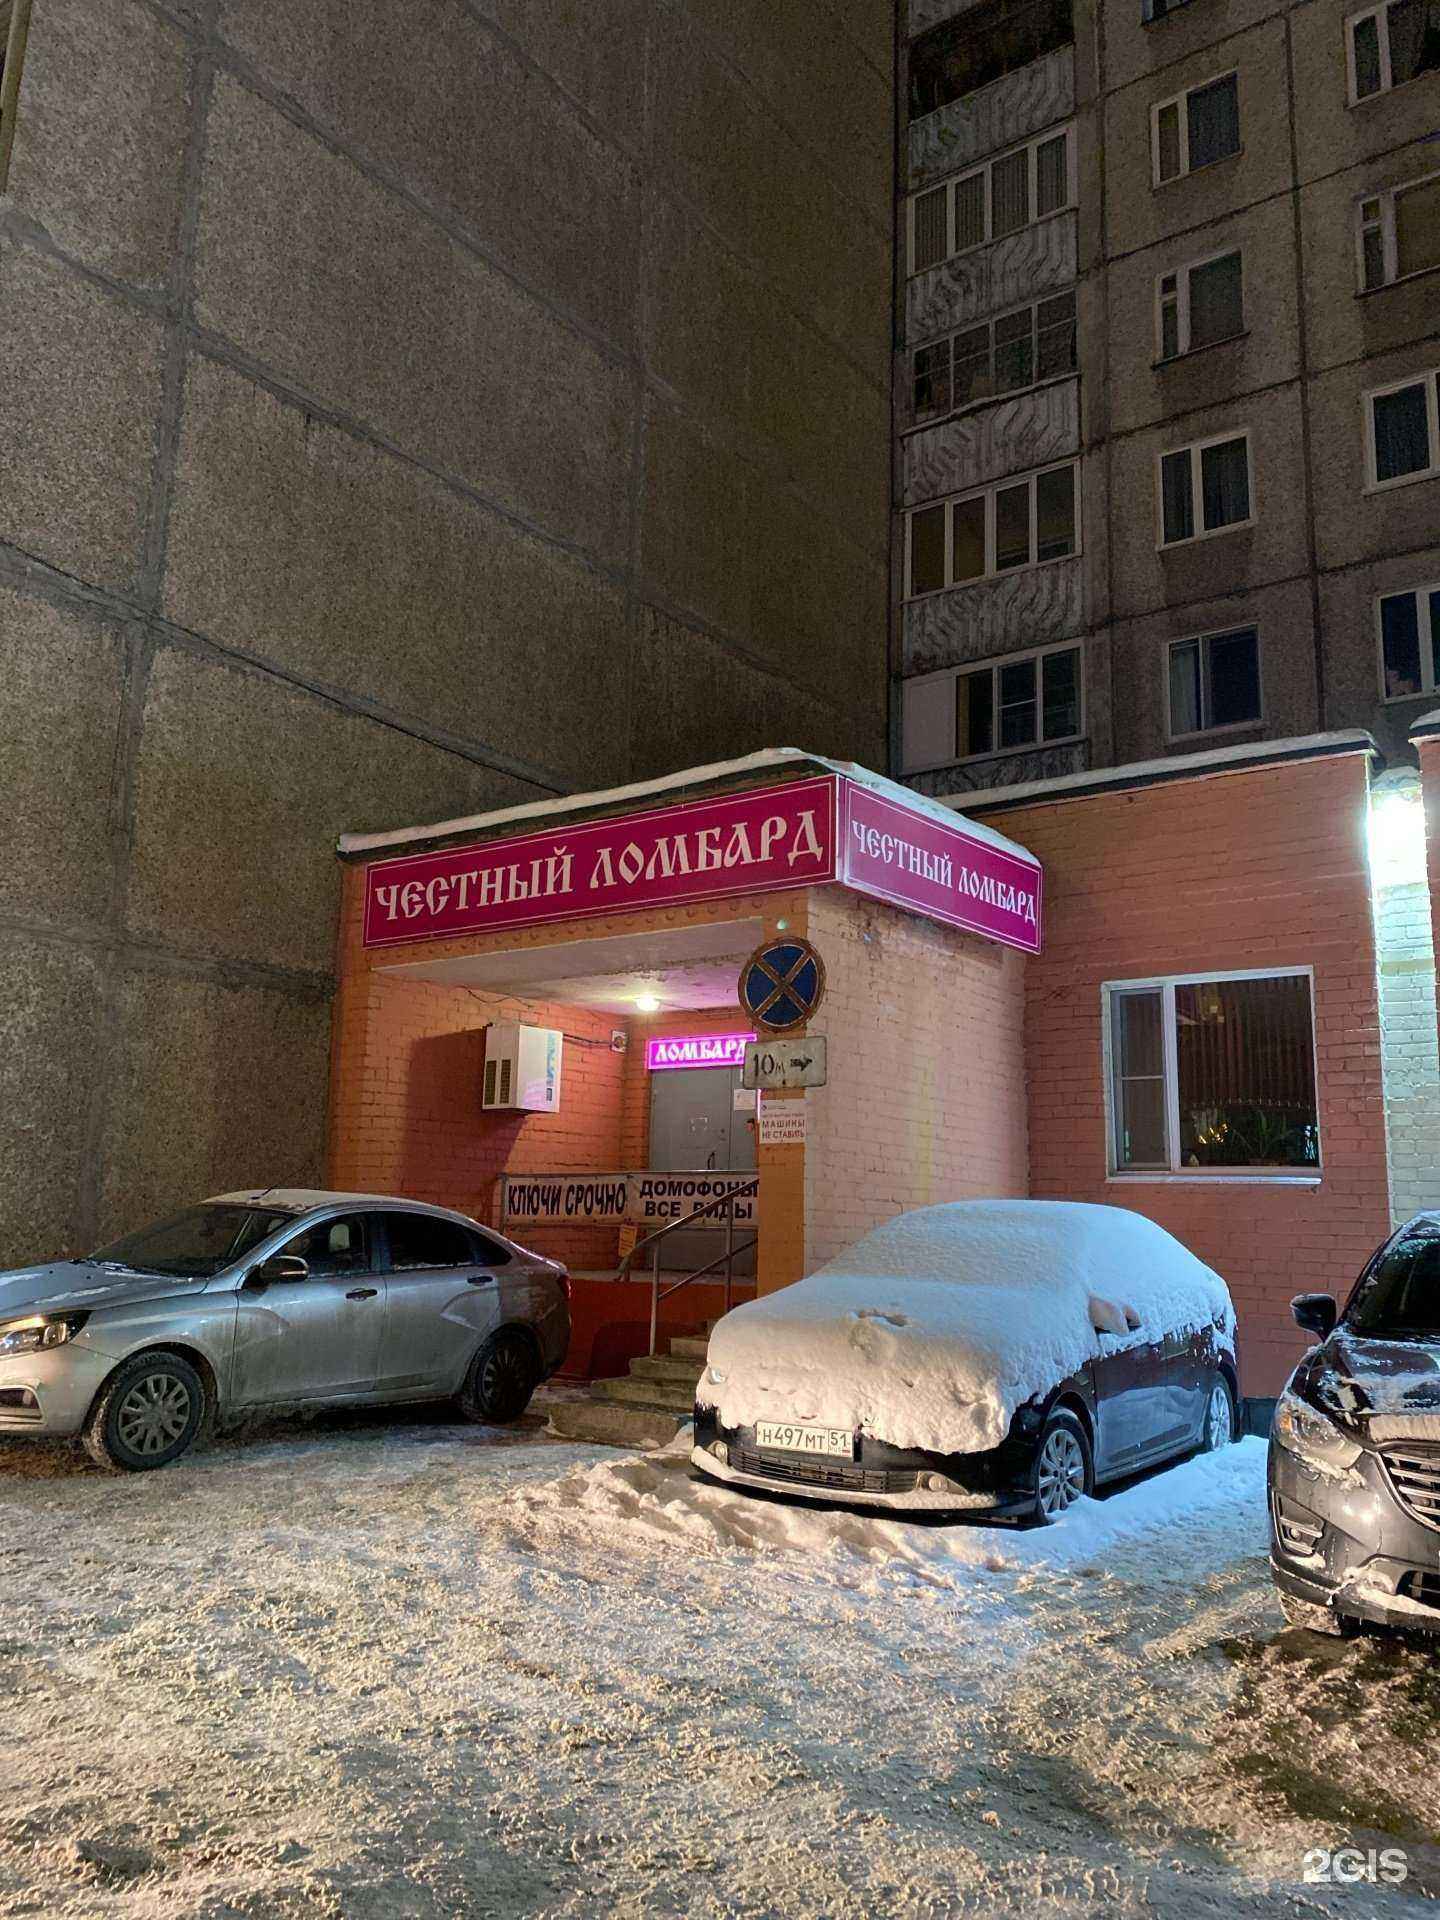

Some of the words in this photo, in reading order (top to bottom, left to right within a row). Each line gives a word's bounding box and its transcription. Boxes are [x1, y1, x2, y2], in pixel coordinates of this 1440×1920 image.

[375, 846, 576, 921] ЧЕСТНЫЙ
[589, 809, 823, 888] ЛОМБАРД
[852, 820, 953, 889] ЧЕСТНЫЙ
[958, 866, 1036, 927] ЛОМБАРД
[762, 1119, 805, 1128] МАШИНЫ
[762, 1131, 772, 1139] НЕ
[773, 1130, 804, 1139] СТАВИТЬ
[640, 1180, 758, 1198] ДОМОФОНЫ
[508, 1185, 562, 1215] КЛЮЧИ
[565, 1183, 626, 1215] СРОЧНО
[645, 1201, 681, 1217] ВСЕ
